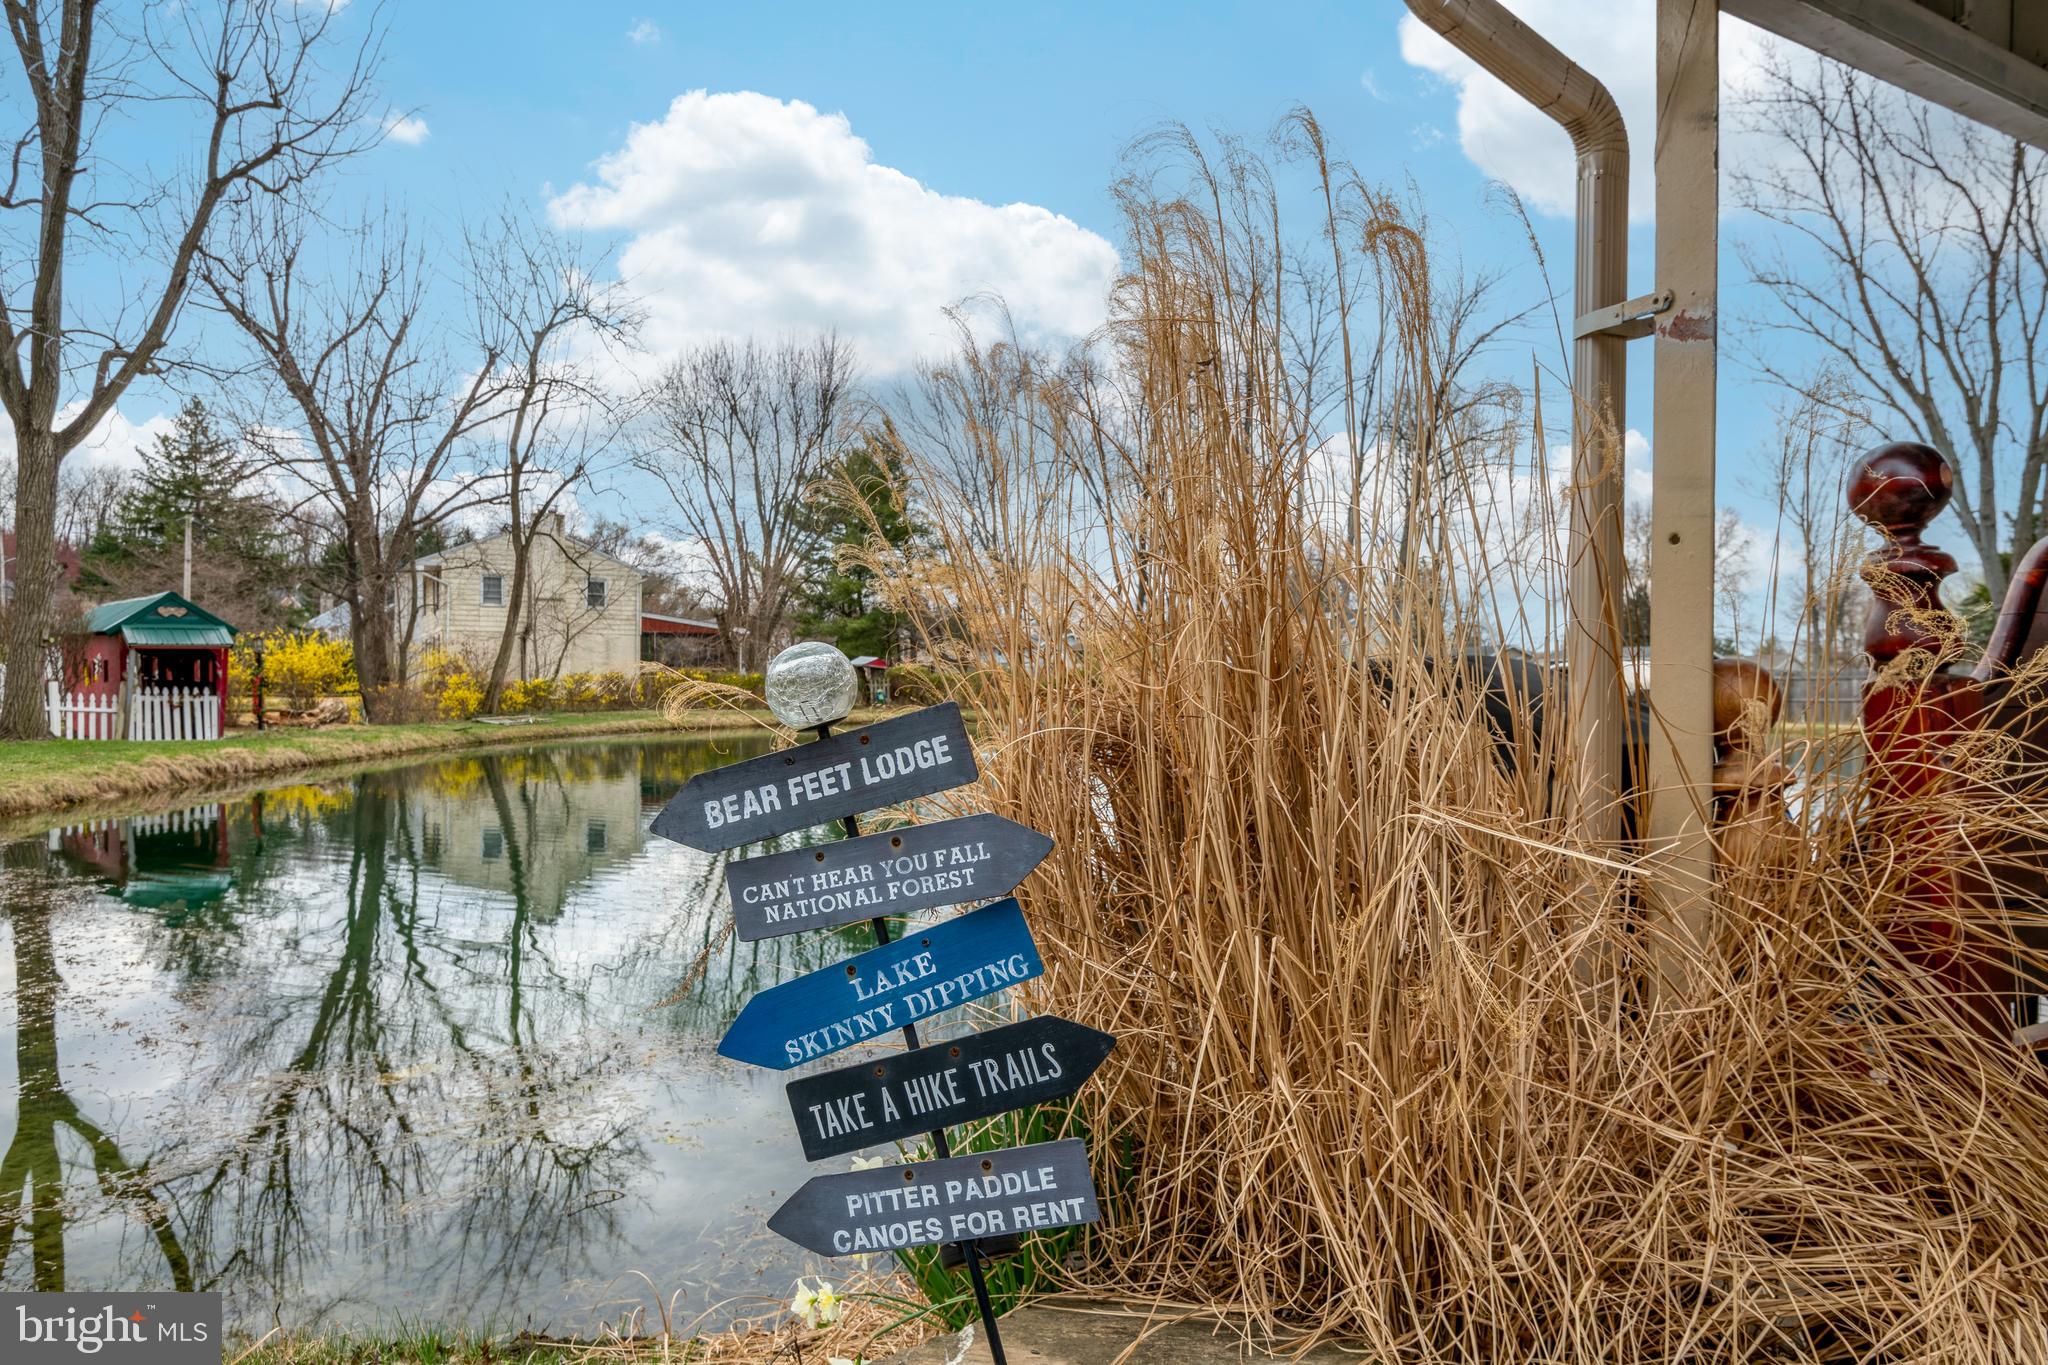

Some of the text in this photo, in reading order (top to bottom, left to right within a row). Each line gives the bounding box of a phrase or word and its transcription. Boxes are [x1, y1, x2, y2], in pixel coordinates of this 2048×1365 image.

[704, 735, 953, 829] BEAR FEET LODGE
[742, 842, 991, 904] CAN'T HEAR YOU FALL
[764, 868, 975, 924] NATIONAL FOREST
[849, 951, 938, 1002] LAKE
[784, 953, 1030, 1063] SKINNY DIPPING
[808, 1042, 1063, 1140] TAKE A HIKE TRAILS
[846, 1167, 1058, 1218] PITTER PADDLE
[832, 1197, 1086, 1253] CANOES FOR RENT
